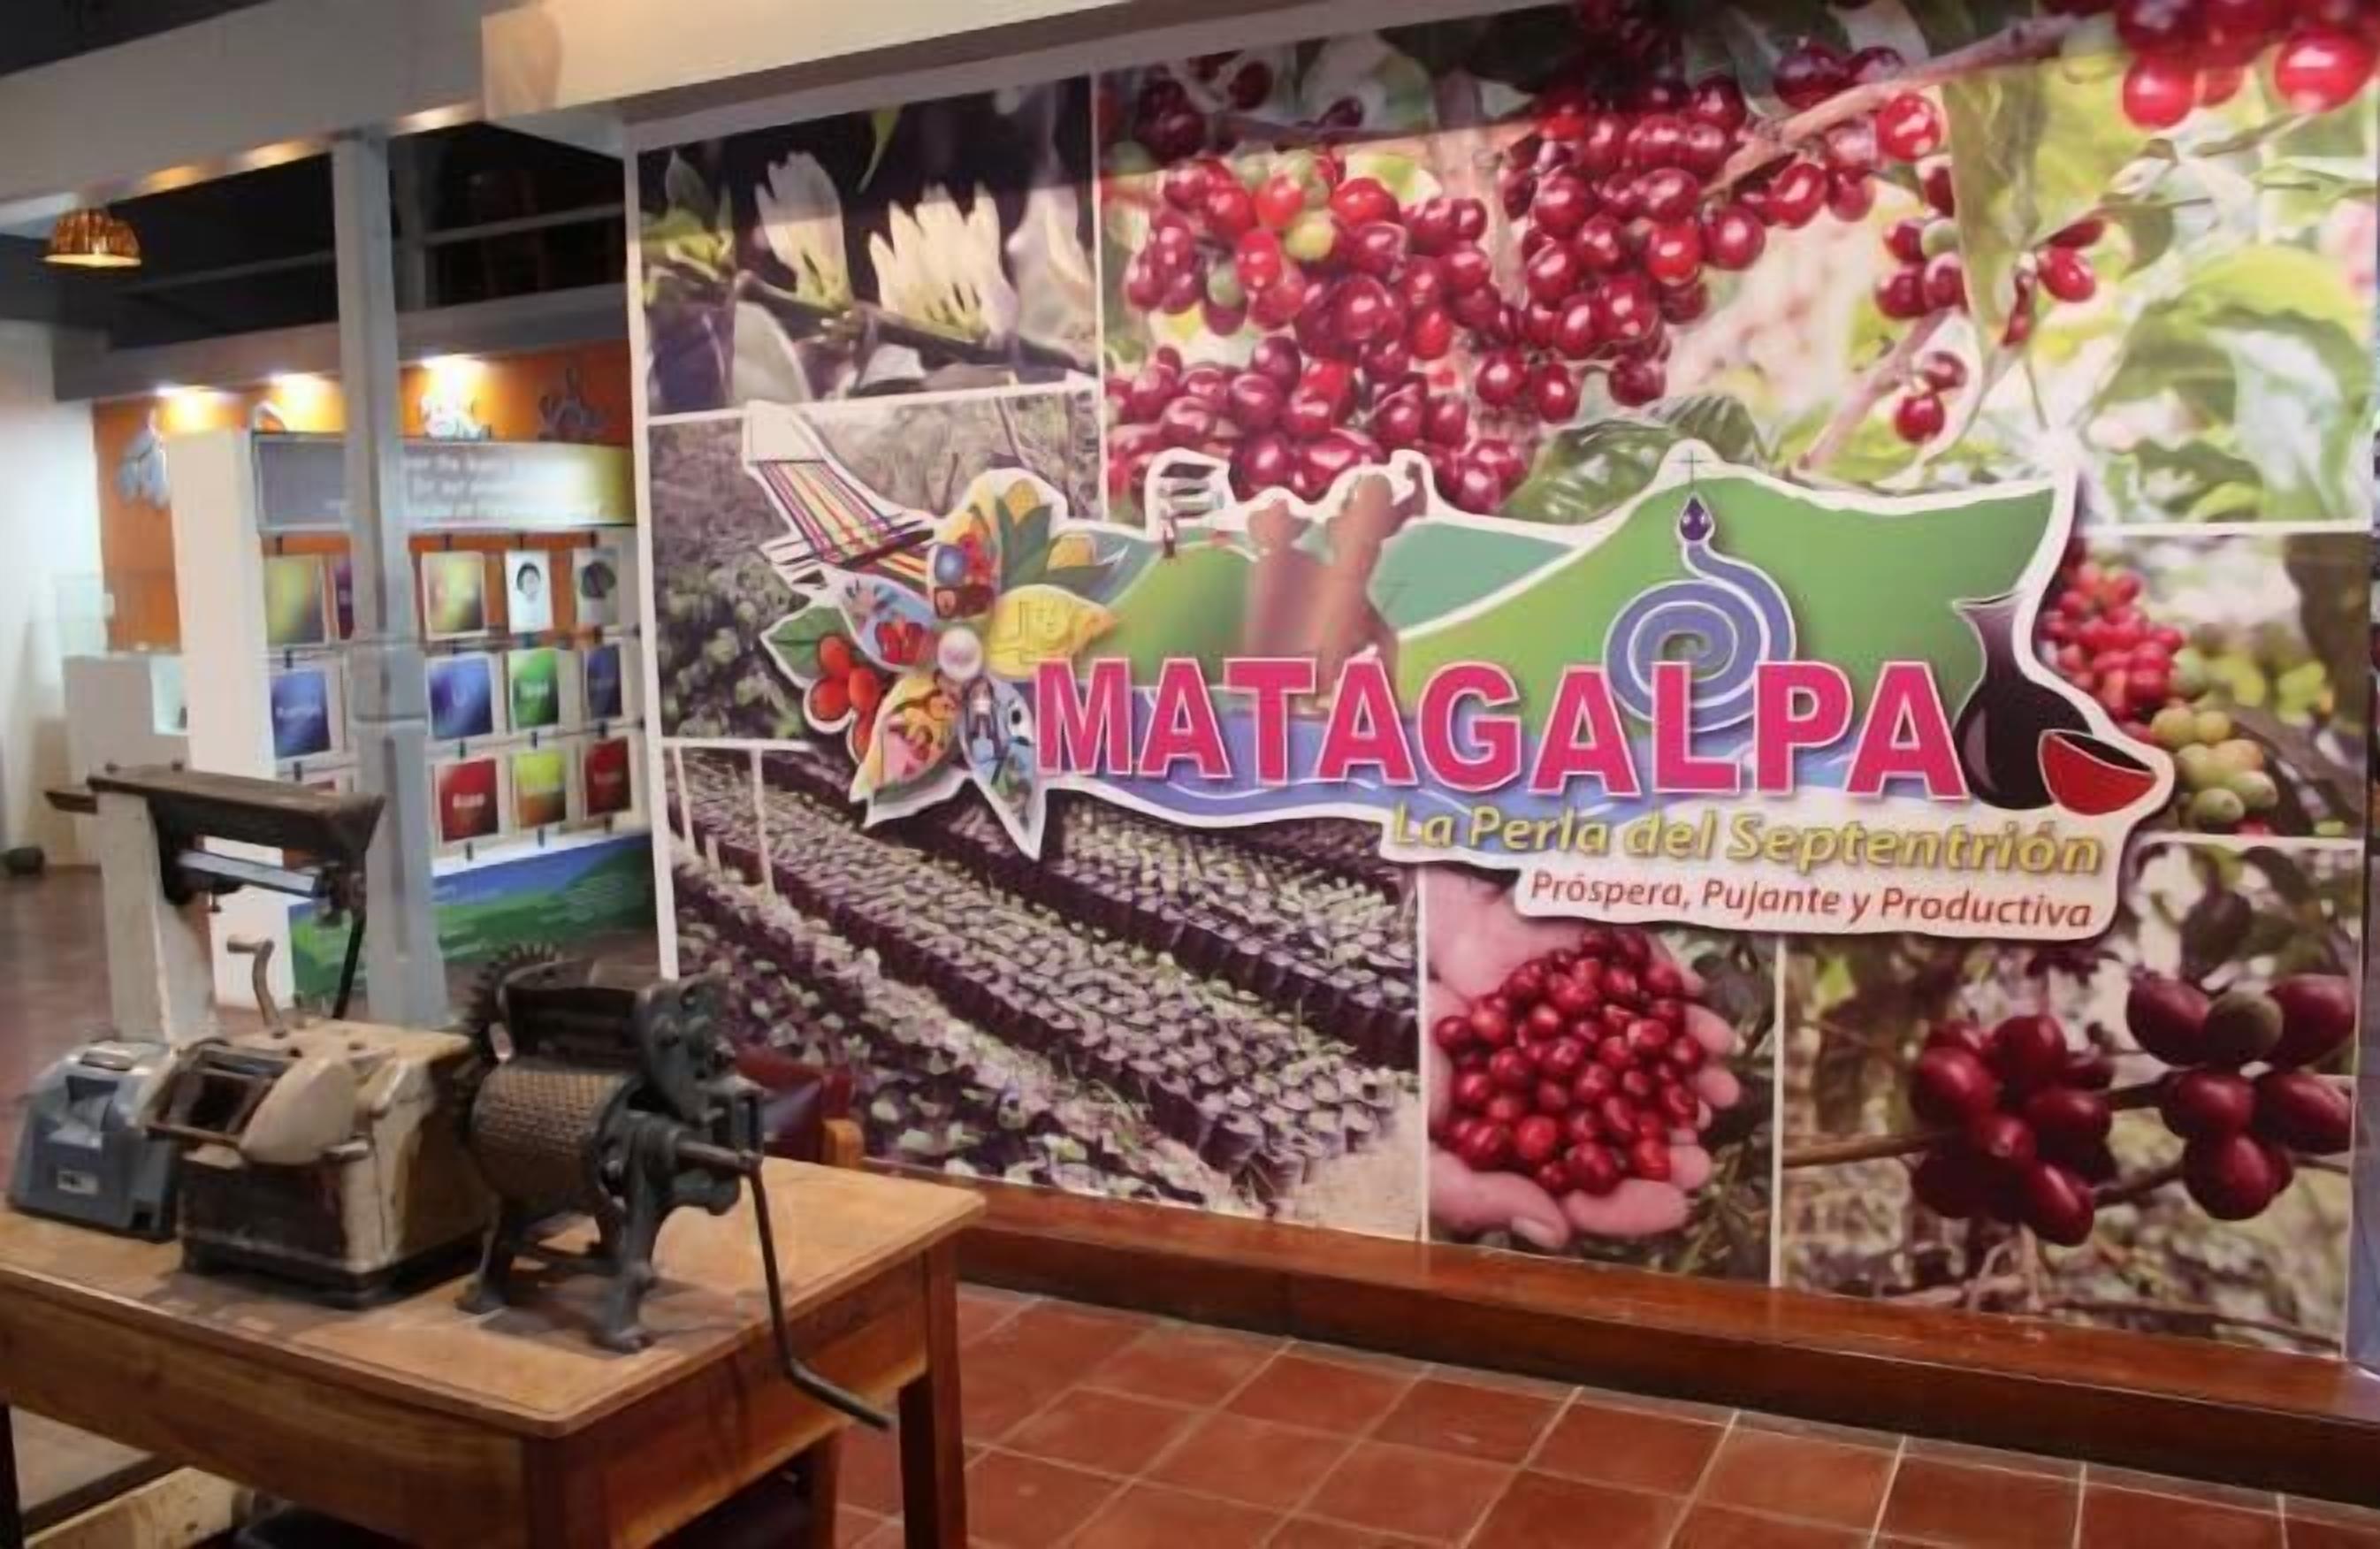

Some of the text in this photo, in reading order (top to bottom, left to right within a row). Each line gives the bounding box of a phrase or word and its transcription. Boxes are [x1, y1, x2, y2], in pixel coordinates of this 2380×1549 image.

[1035, 656, 1970, 799] MATAGALPA
[1392, 801, 2102, 874] La Perla del Septentrión
[1530, 869, 2092, 928] Próspera, Pujante y Productiva
